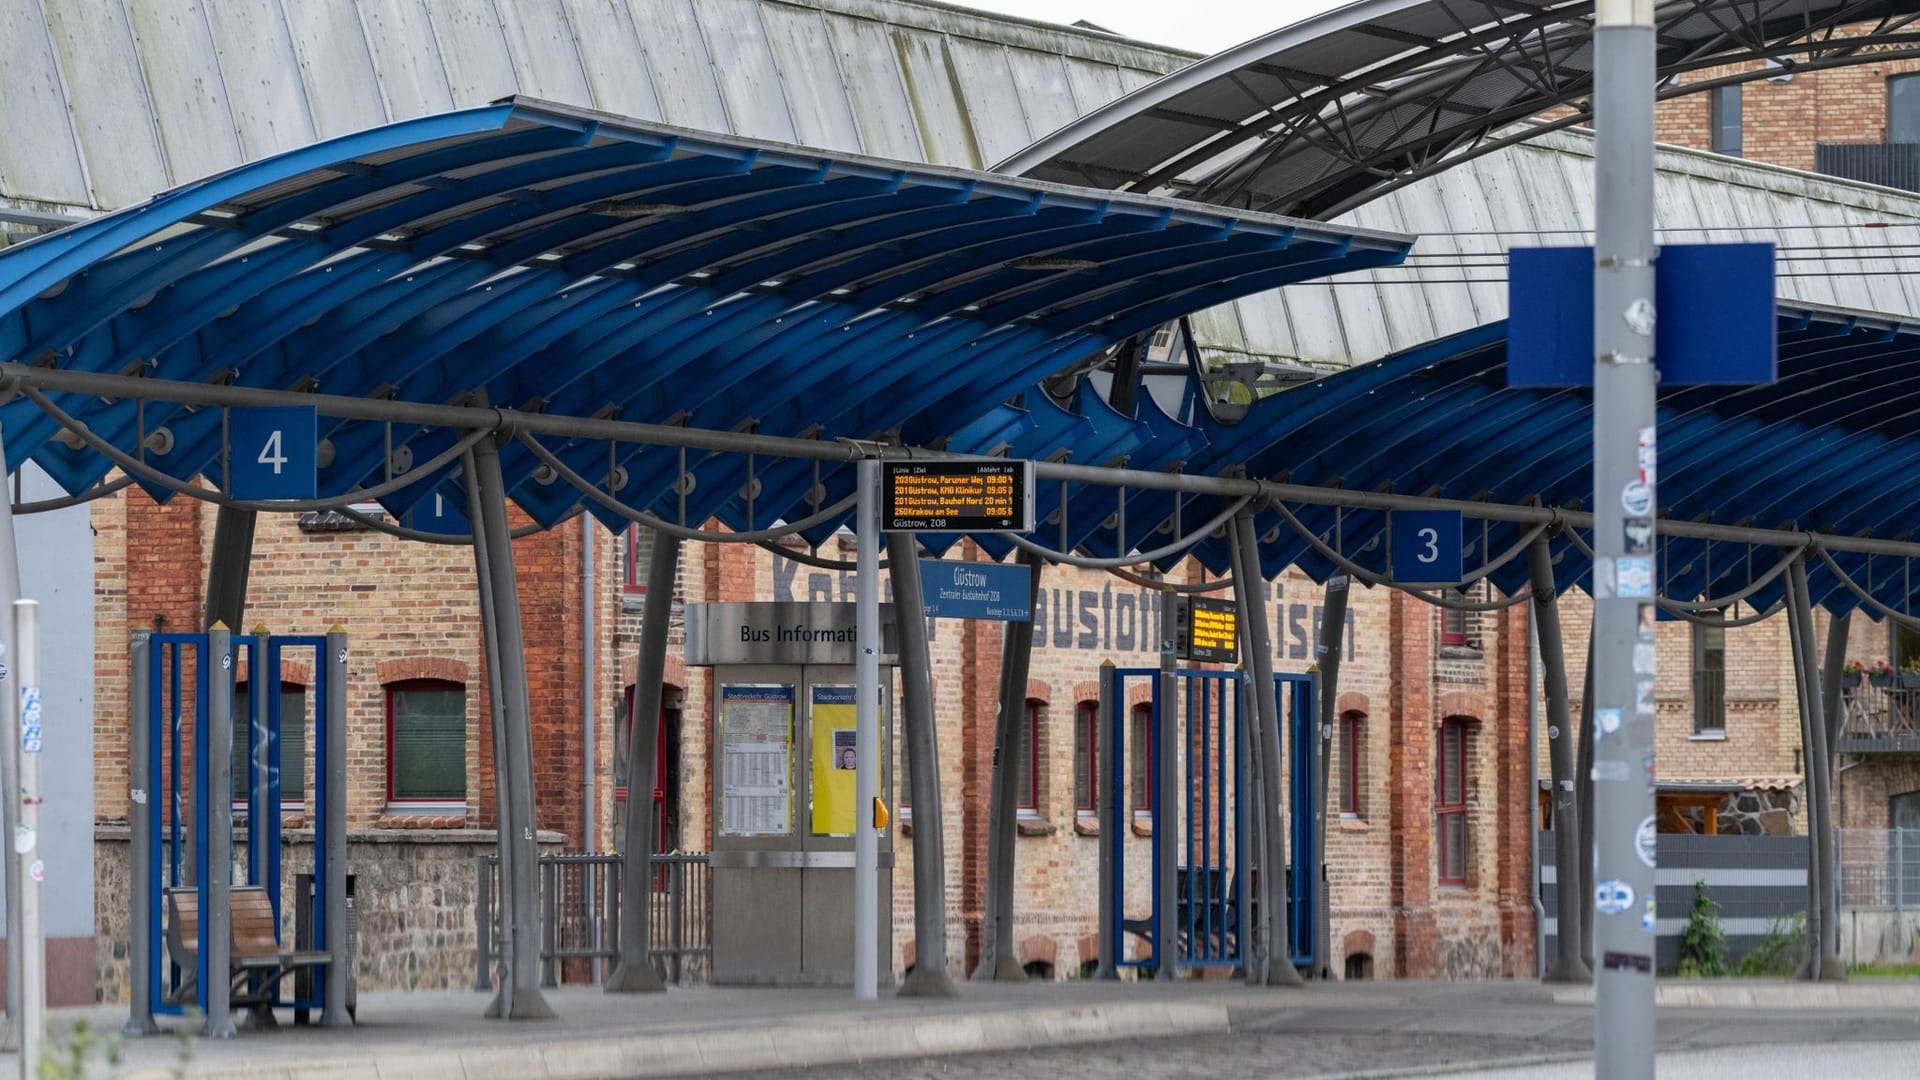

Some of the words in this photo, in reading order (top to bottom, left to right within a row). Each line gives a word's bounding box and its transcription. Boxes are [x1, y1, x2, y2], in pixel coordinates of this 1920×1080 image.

[257, 430, 288, 475] 4
[895, 475, 908, 484] 203
[1008, 475, 1013, 484] 4
[895, 486, 908, 495] 201
[986, 486, 1007, 495] 09:05
[895, 497, 908, 505] 201
[940, 497, 965, 505] Bauhof
[966, 497, 983, 505] Nord
[984, 497, 994, 505] 20
[995, 497, 1007, 505] min
[1008, 497, 1013, 505] 1
[908, 507, 934, 516] Krakow
[946, 507, 959, 516] See
[893, 518, 928, 528] Güstrow,
[930, 518, 947, 528] ZOB
[1417, 527, 1439, 563] 3
[953, 567, 987, 587] Güstrow
[940, 588, 961, 600] Zentraler
[962, 588, 990, 601] Busbahnhof
[740, 624, 770, 643] Bus
[776, 624, 858, 643] Informati
